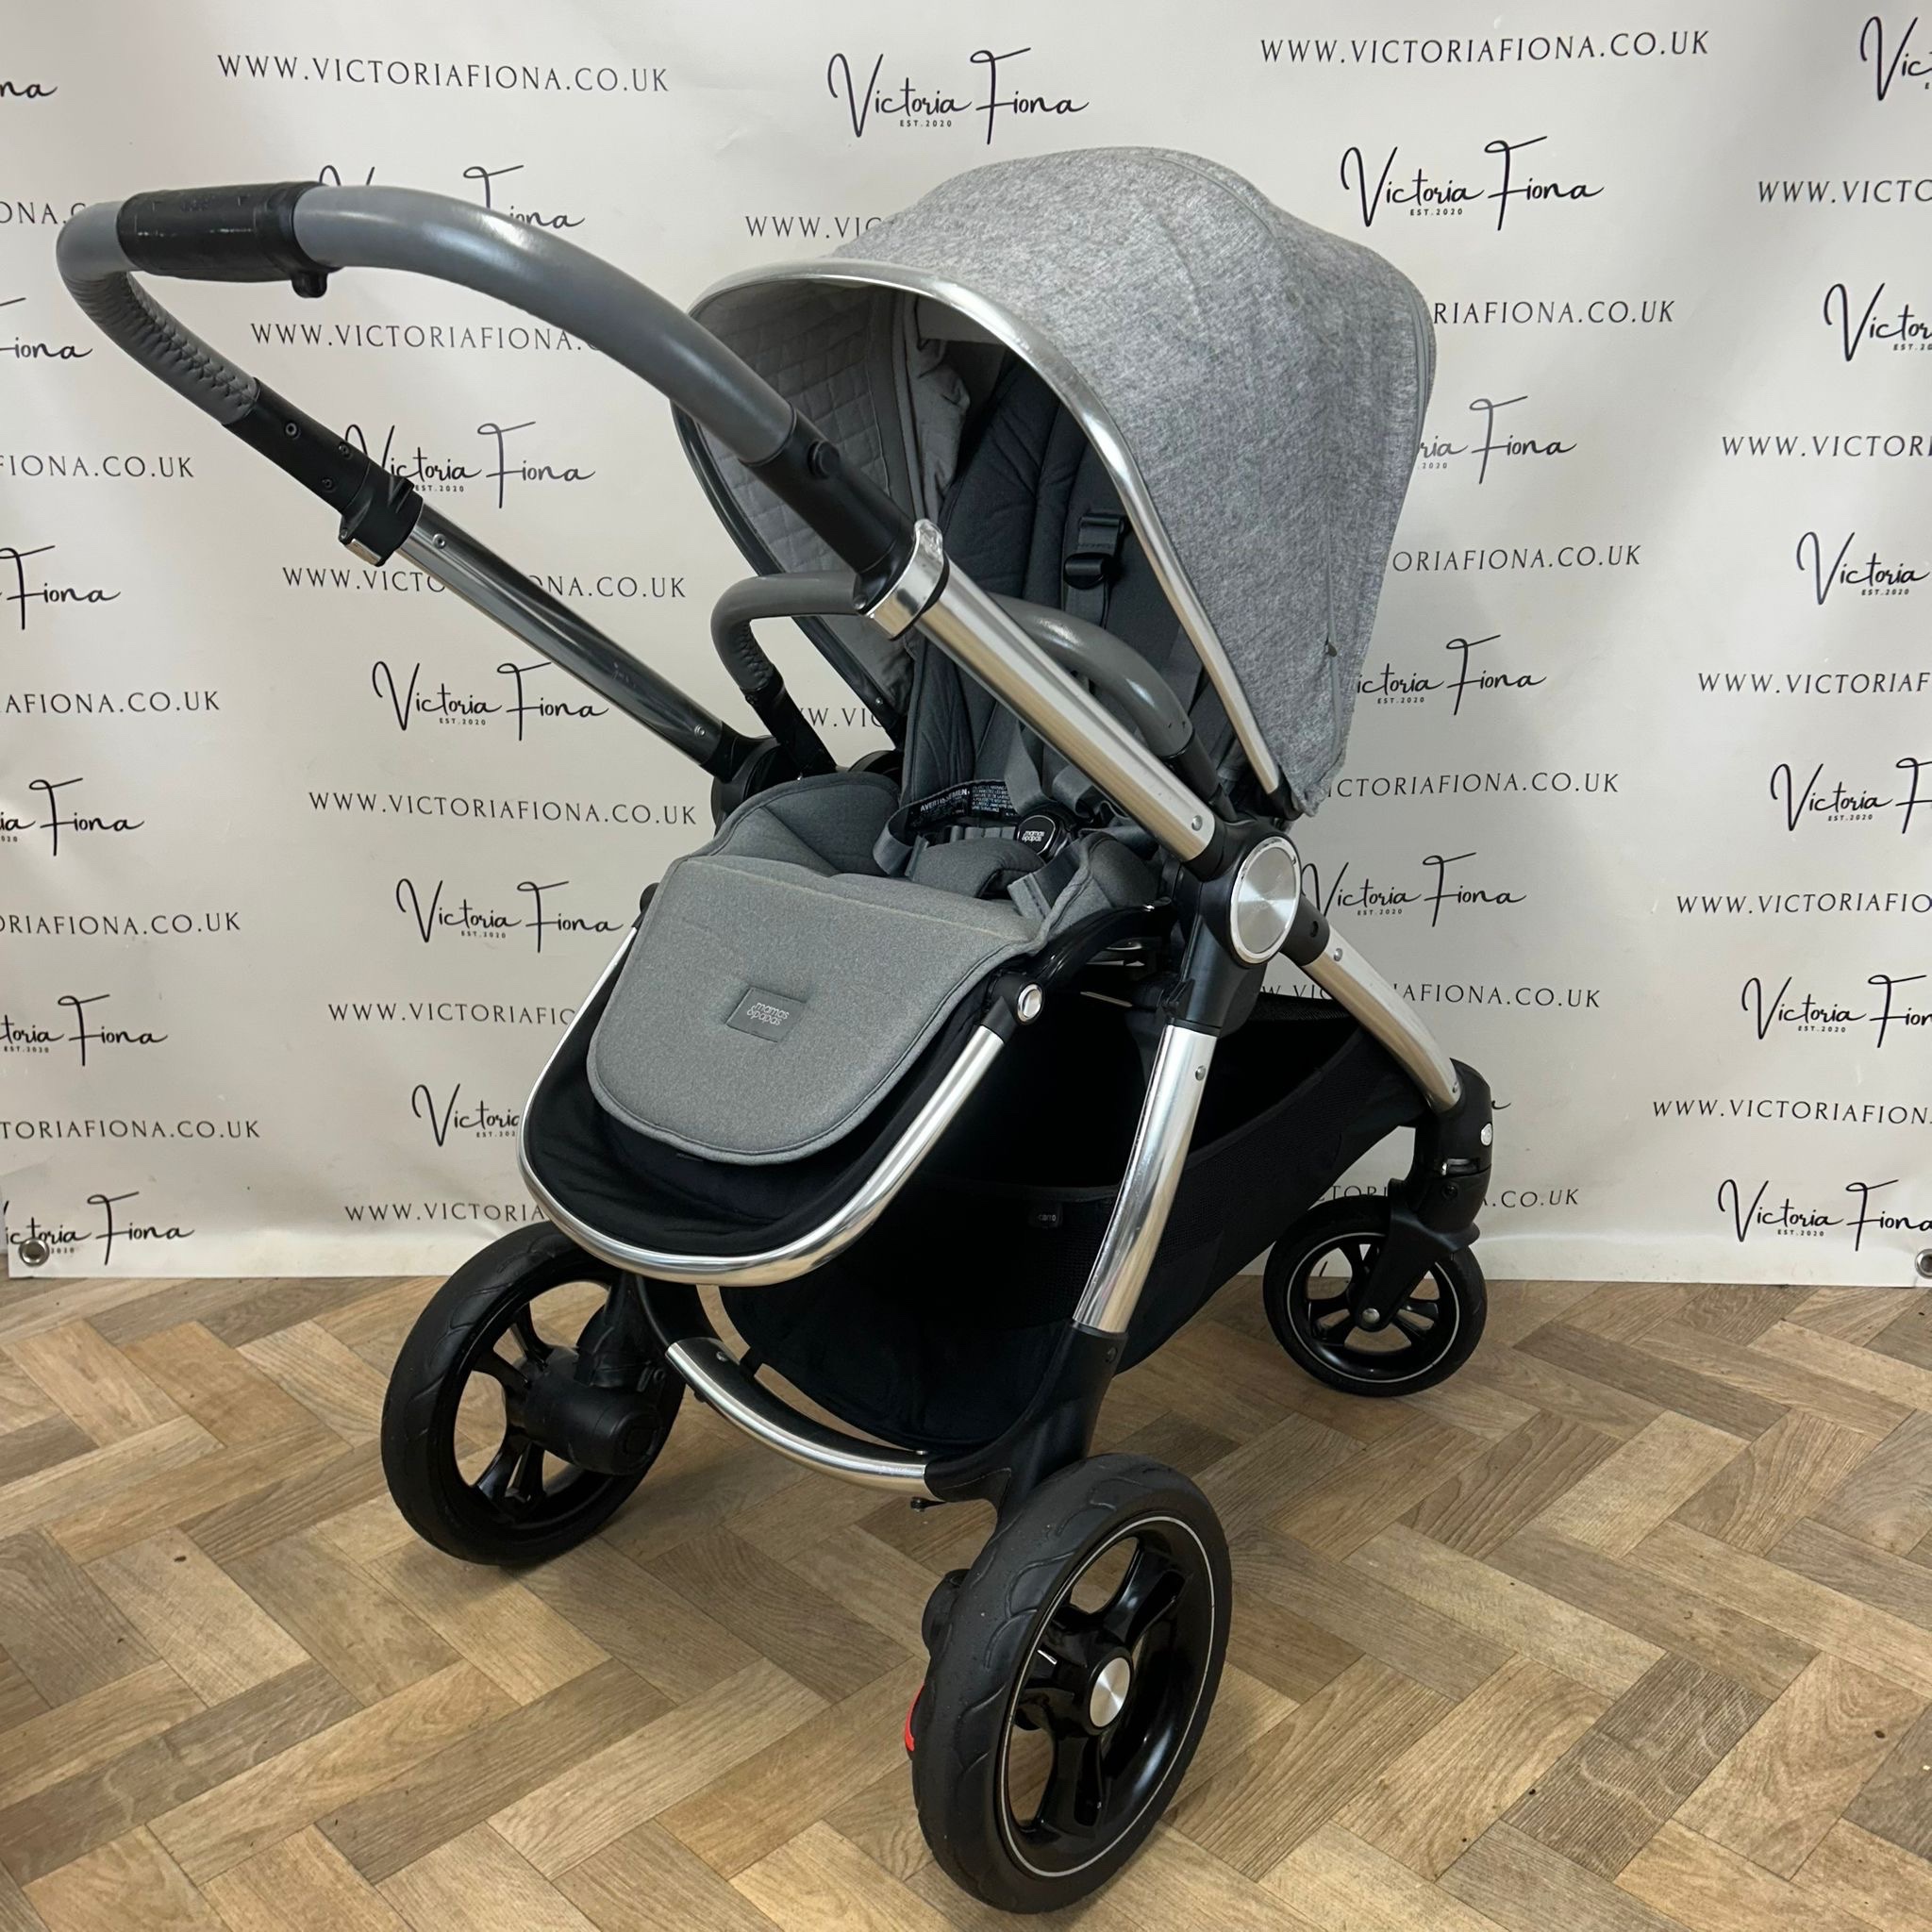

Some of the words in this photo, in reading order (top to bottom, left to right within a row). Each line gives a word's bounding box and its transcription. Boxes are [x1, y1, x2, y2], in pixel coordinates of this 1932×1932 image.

[217, 55, 669, 92] WWW.VICTORIAFIONA.CO.UK
[1260, 30, 1708, 63] WWW.VICTORIAFIONA.CO.UK
[827, 53, 973, 138] Victoria
[970, 47, 1090, 145] Fiona
[1341, 146, 1485, 227] Victoria
[1484, 136, 1605, 231] Fiona
[1410, 208, 1462, 216] EST.2020
[251, 324, 598, 351] WWW.VICTORIAFIONA.
[477, 421, 595, 508] Fiona
[1469, 395, 1577, 485] Fiona
[1796, 531, 1931, 606] Victoria
[372, 660, 503, 731] Victoria
[497, 661, 609, 741] Fiona
[1445, 634, 1547, 716] Fiona
[28, 777, 145, 857] Fiona
[308, 792, 696, 824] WWW.VICTORIAFIONA.CO.UK
[1770, 763, 1893, 831] Victoria
[0, 911, 241, 935] RIAFIONA.CO.UK
[396, 878, 522, 943] Victoria
[517, 881, 624, 954] Fiona
[1423, 852, 1527, 927] Fiona
[58, 994, 168, 1067] Fiona
[746, 1006, 782, 1025] &papas
[755, 1002, 790, 1020] mamas
[1741, 976, 1867, 1040] Victoria
[87, 1191, 194, 1266] Fiona
[1718, 1179, 1844, 1242] Victoria
[1777, 1228, 1824, 1237] EST.2020
